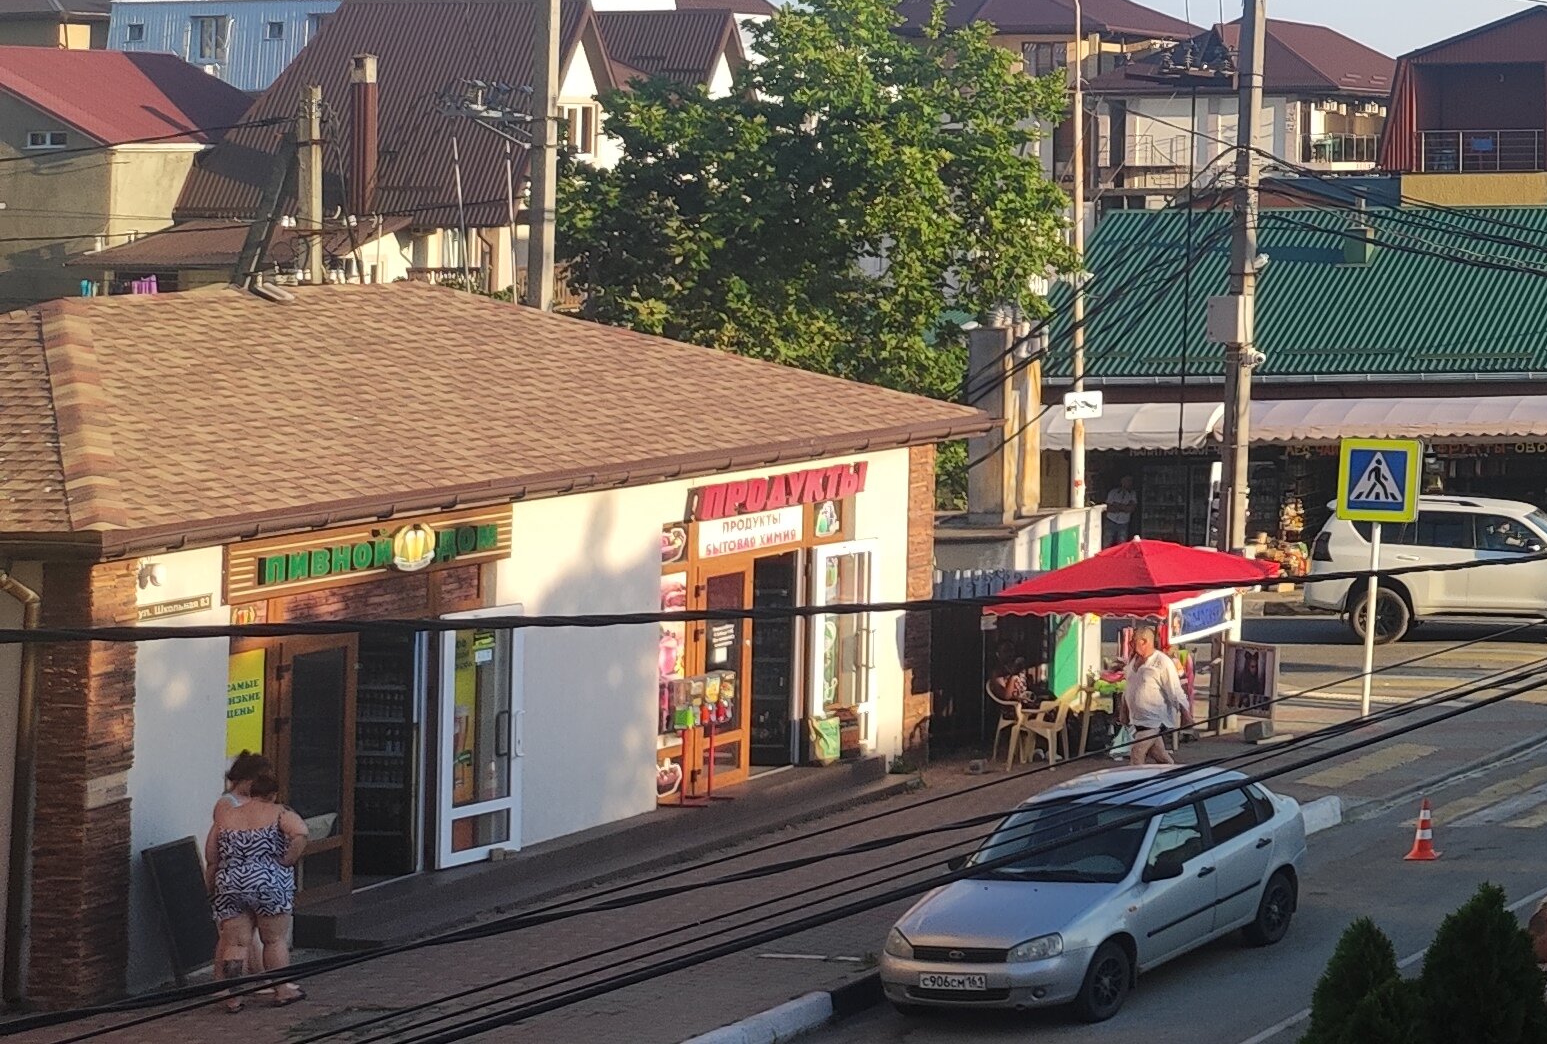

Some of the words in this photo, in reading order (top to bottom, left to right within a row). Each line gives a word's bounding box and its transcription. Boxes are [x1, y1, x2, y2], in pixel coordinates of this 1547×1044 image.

[700, 460, 869, 521] ПРОДУКТЫ
[705, 534, 756, 556] БЫТОВАЯ
[759, 529, 797, 547] ХИМИЯ
[722, 512, 781, 534] ПРОДУКТЫ
[263, 527, 395, 585] ПИВНОЙ
[434, 523, 499, 562] ДОМ
